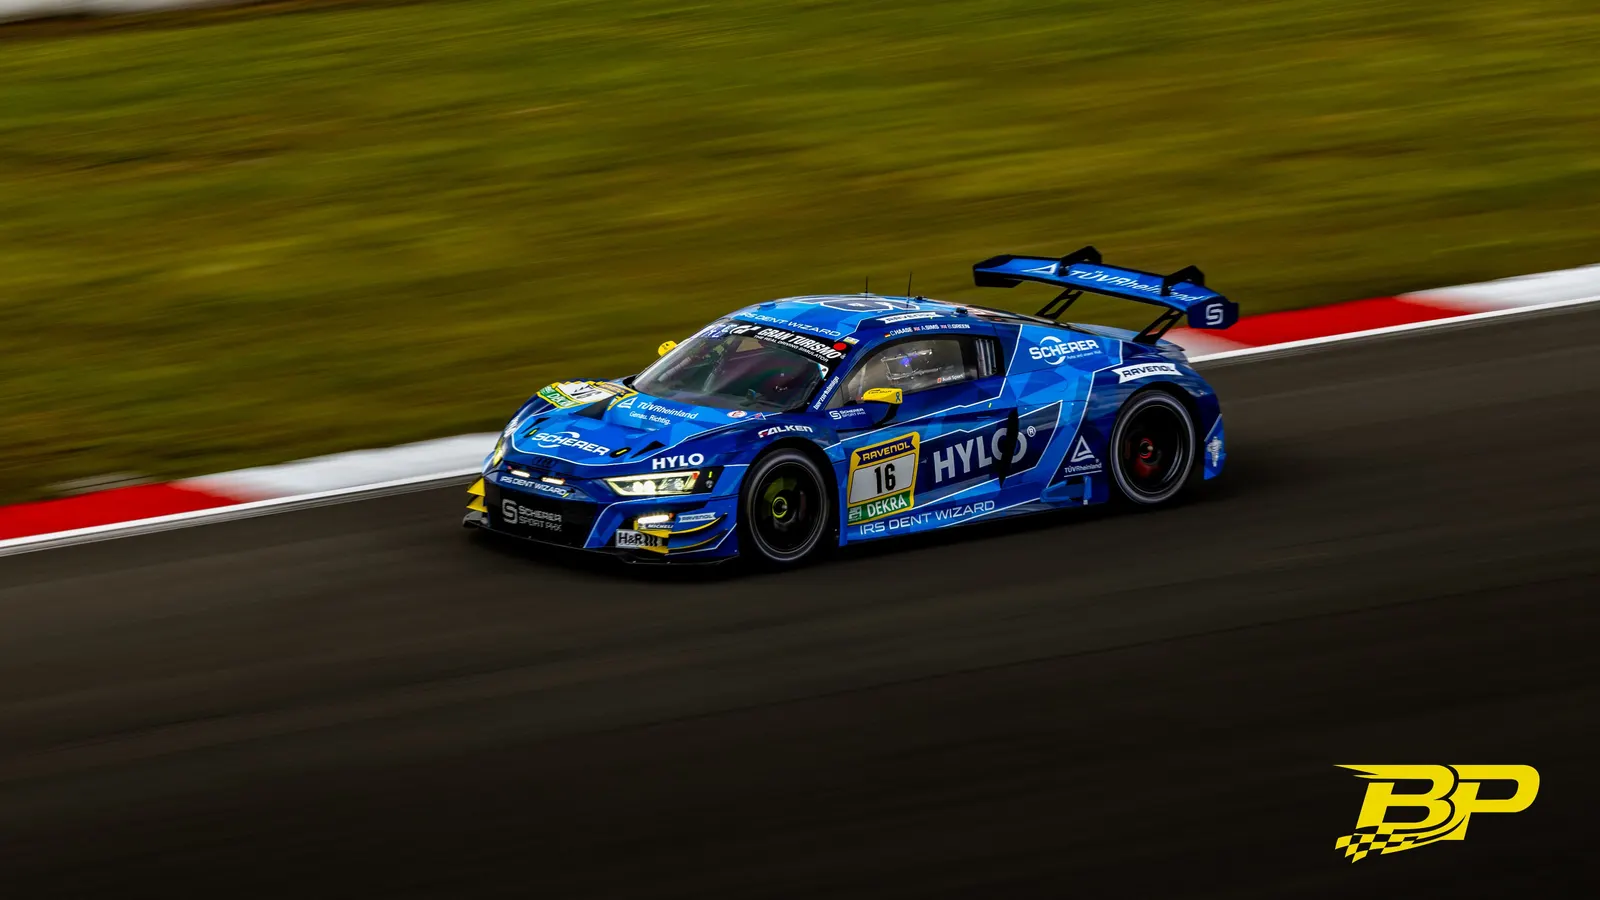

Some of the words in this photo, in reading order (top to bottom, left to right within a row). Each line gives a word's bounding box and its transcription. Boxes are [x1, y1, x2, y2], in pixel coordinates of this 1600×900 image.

[1069, 269, 1206, 303] TÜVRheinand
[758, 315, 788, 325] DENT
[788, 320, 841, 337] WIZARD
[757, 326, 789, 343] GRAN
[791, 333, 842, 359] TURISMO
[1029, 339, 1099, 360] SCHERER
[798, 345, 829, 363] SIMULATOR
[1122, 365, 1175, 378] RAVENOL
[637, 401, 699, 420] TÜVRheinland
[758, 425, 813, 438] FALKEN
[532, 432, 610, 456] SCHERER
[863, 441, 910, 461] RAVENOL
[652, 453, 704, 470] HYLO
[1064, 462, 1102, 474] TÜVRheinland
[515, 478, 534, 488] DENT
[534, 483, 567, 496] WIZARD
[874, 463, 896, 494] 16
[518, 505, 562, 522] SCHERER
[867, 495, 908, 517] DEKRA
[518, 516, 545, 528] SPORT
[860, 521, 885, 535] IRS
[889, 512, 932, 530] DENT
[935, 500, 995, 520] WIZARD
[619, 533, 643, 545] H&R
